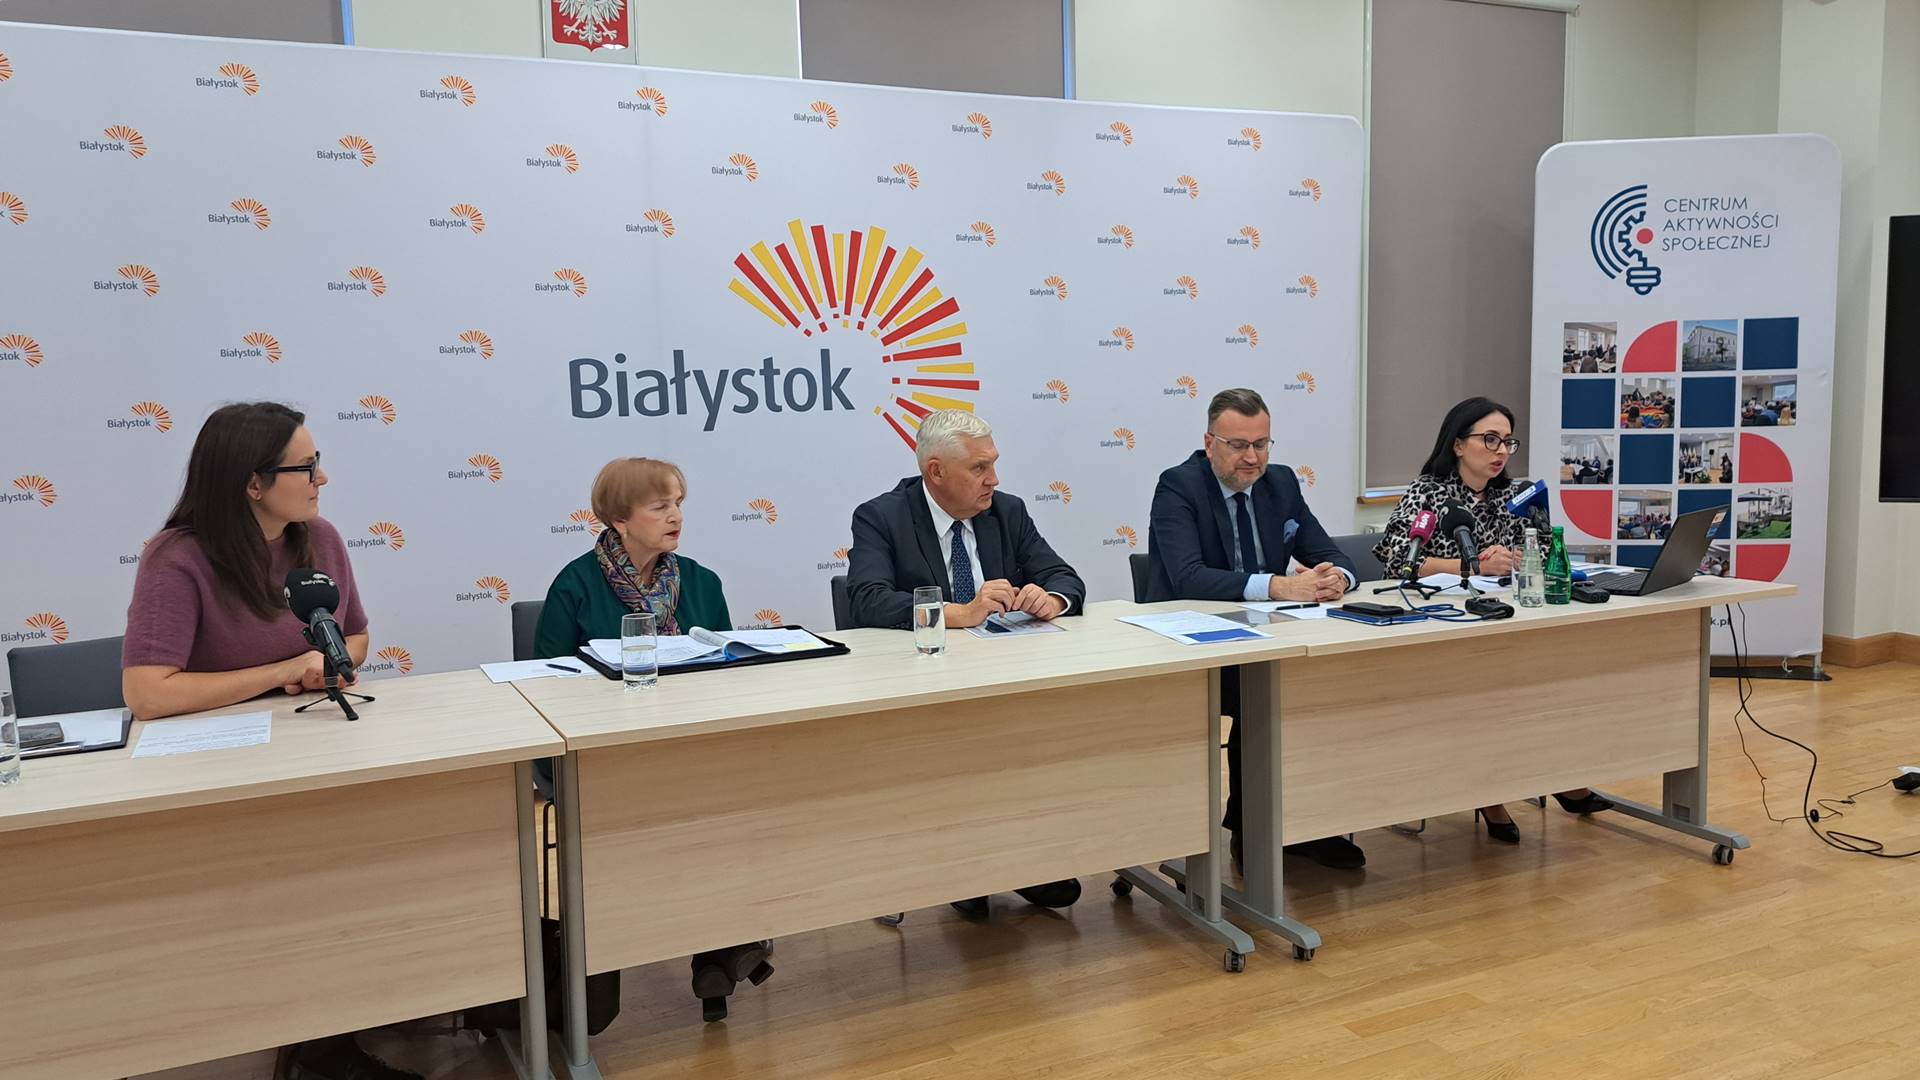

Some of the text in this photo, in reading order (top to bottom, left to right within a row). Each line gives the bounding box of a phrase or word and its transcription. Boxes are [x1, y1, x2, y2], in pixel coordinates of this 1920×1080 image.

[196, 77, 239, 89] Białystok
[420, 90, 457, 100] Białystok
[618, 101, 651, 111] Białystok
[794, 113, 823, 123] Białystok
[952, 125, 979, 134] Białystok
[80, 141, 124, 152] Białystok
[317, 150, 357, 161] Białystok
[527, 158, 561, 168] Białystok
[712, 167, 743, 176] Białystok
[877, 176, 905, 184] Białystok
[1664, 197, 1748, 213] CENTRUM
[208, 214, 250, 224] Białystok
[430, 218, 467, 229] Białystok
[1662, 211, 1780, 232] AKTYWNOŚCI
[626, 224, 659, 234] Białystok
[1662, 234, 1771, 252] SPOŁECZNEJ
[94, 281, 138, 291] Białystok
[328, 282, 367, 292] Białystok
[535, 283, 570, 293] Białystok
[221, 348, 262, 358] Białystok
[440, 345, 476, 355] Białystok
[568, 348, 856, 432] Białystok
[338, 411, 377, 421] Białystok
[107, 418, 150, 429] Białystok
[448, 469, 484, 479] Białystok
[0, 491, 35, 504] ałystok
[732, 512, 762, 522] Białystok
[551, 524, 585, 534] Białystok
[348, 538, 386, 548] Białystok
[817, 560, 847, 570] Białystok
[456, 591, 492, 602] Białystok
[0, 629, 47, 643] Białystok
